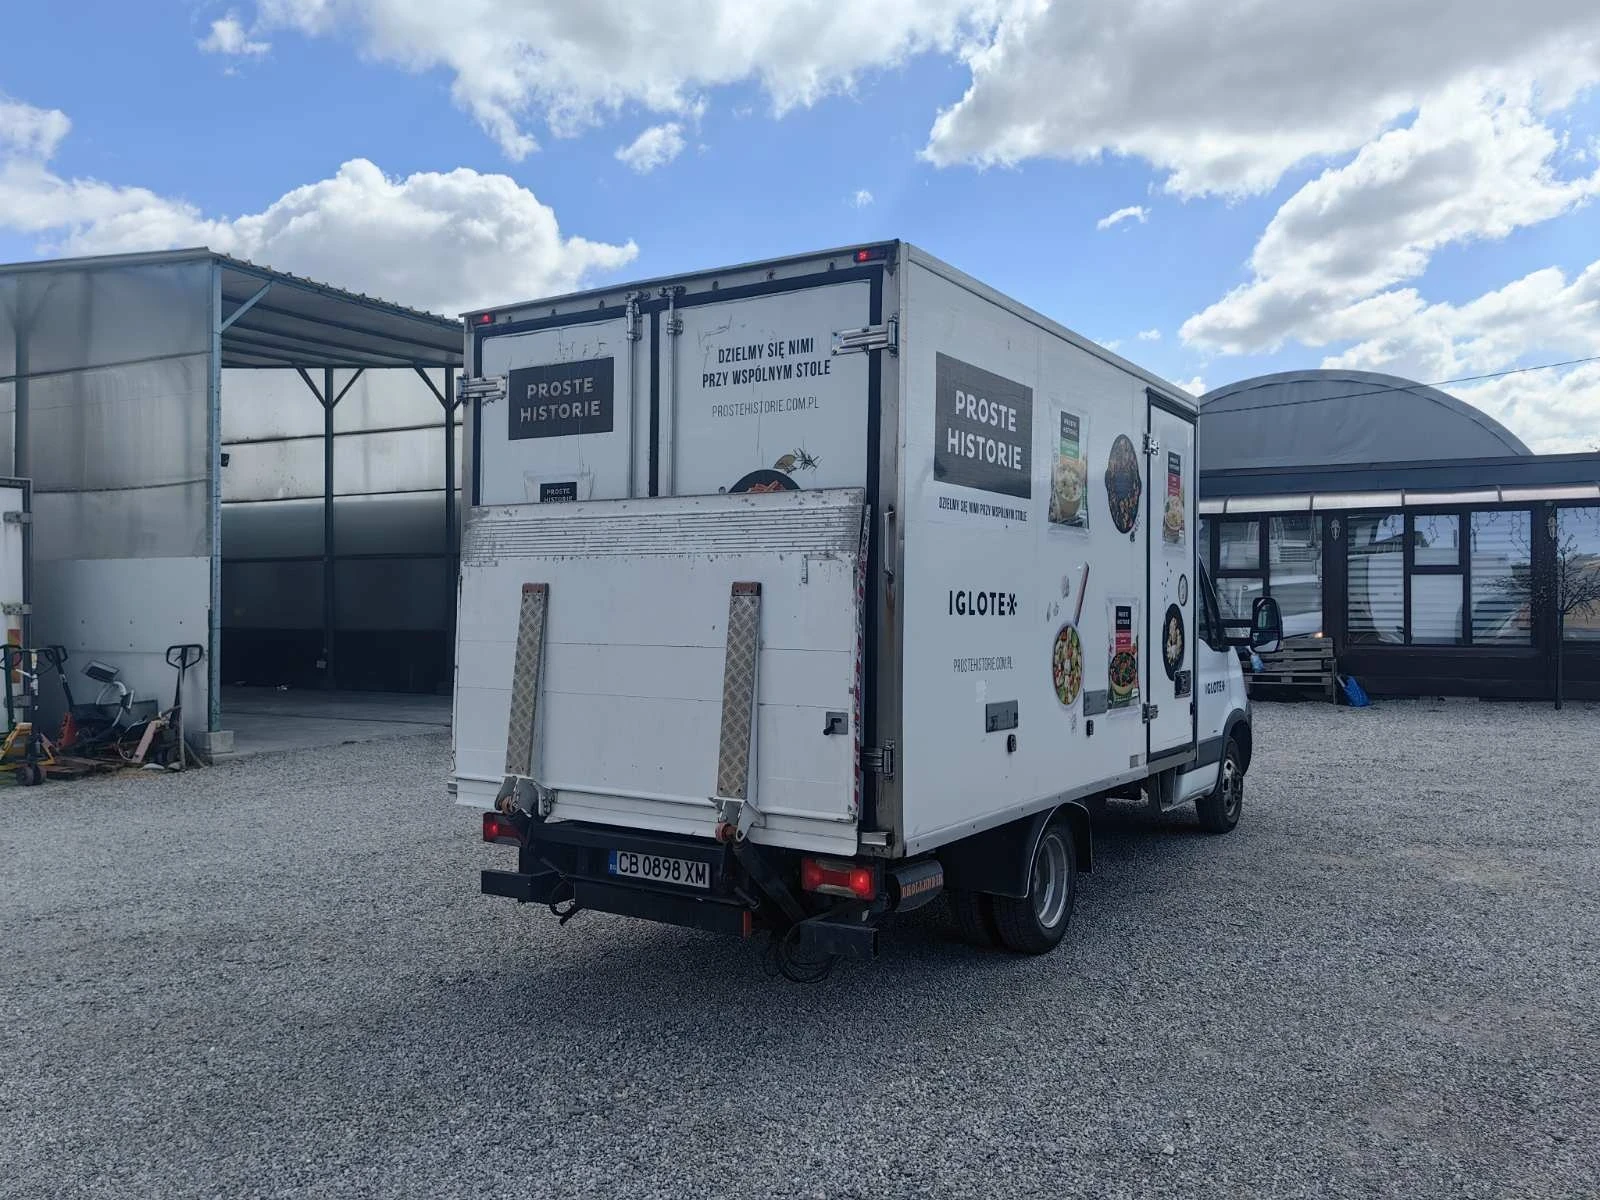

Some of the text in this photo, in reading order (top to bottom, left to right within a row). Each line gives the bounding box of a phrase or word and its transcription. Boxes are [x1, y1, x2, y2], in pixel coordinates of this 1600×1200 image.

[718, 337, 814, 364] DZIELMY SIĘ NIMI
[702, 359, 831, 389] PRZY WSPÓLNYM STOLE
[527, 377, 594, 399] PROSTE
[520, 400, 601, 423] HISTORIE
[712, 396, 820, 417] PROSTEHISTORIE.COM.PL
[955, 390, 1017, 432] PROSTE
[947, 427, 1022, 470] HISTORIE
[949, 590, 1017, 616] IGLOTEX
[619, 853, 706, 884] CB 0898 XM
